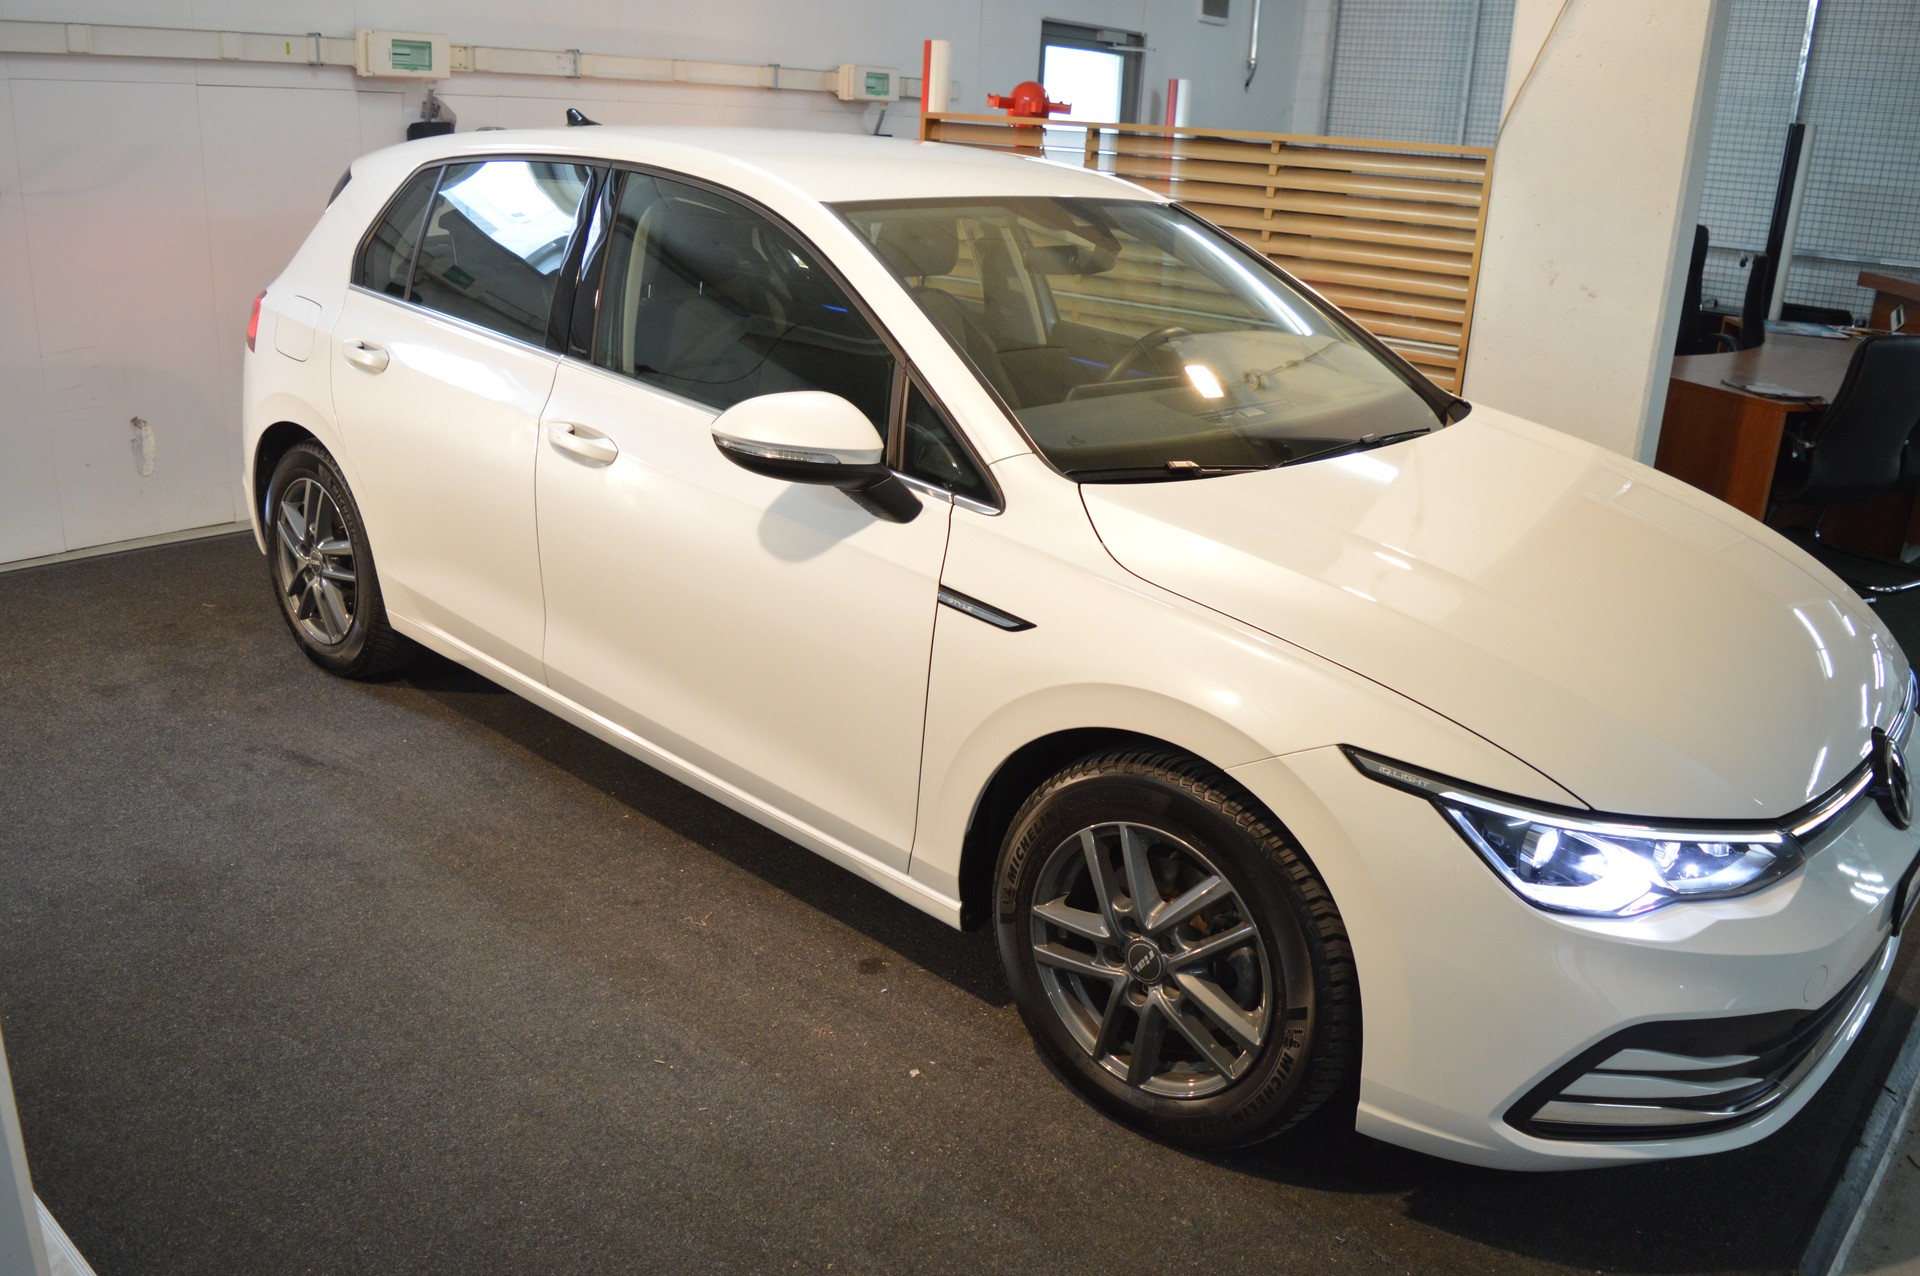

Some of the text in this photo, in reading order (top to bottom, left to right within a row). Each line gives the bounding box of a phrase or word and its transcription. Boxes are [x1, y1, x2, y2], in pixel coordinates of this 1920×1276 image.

[947, 597, 974, 613] STYLE
[1379, 765, 1431, 788] IQ.LIGHT
[1007, 808, 1056, 886] MICHELIN
[1231, 1052, 1294, 1123] MICHELIN
